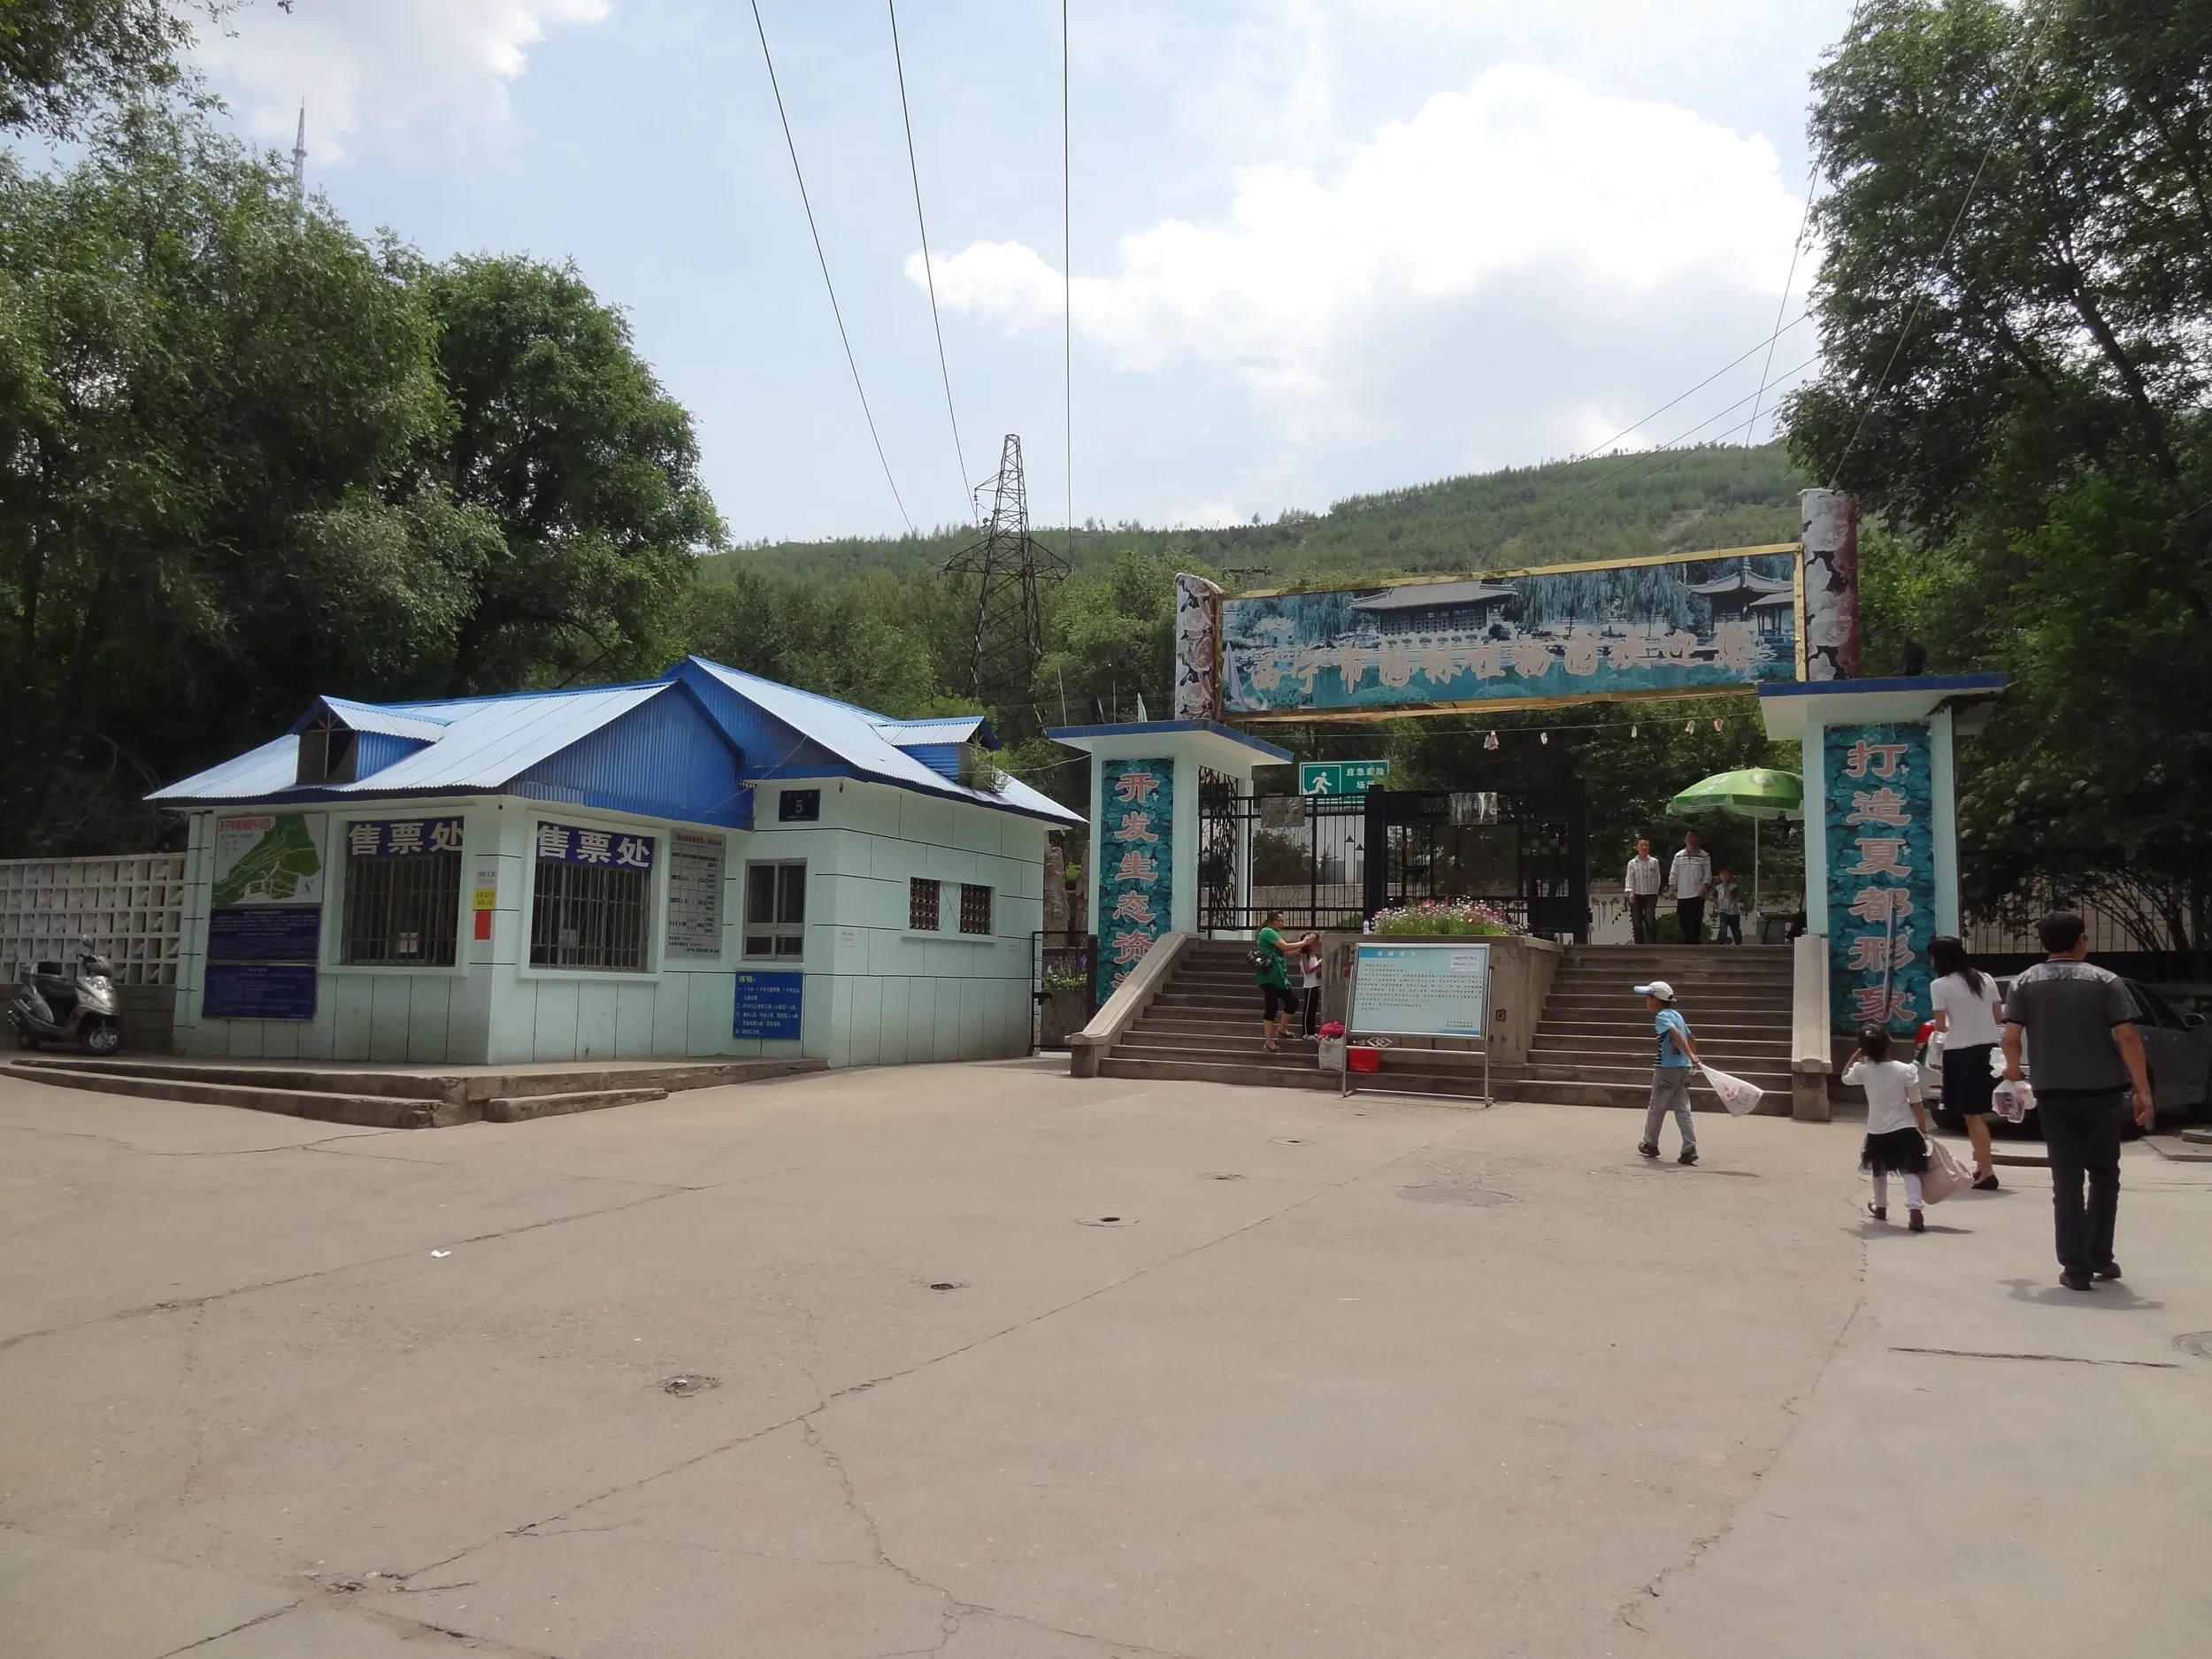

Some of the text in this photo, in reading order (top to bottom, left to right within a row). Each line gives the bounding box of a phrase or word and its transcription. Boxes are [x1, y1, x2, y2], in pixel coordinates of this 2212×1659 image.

[1346, 767, 1385, 777] 应急避险
[795, 799, 803, 814] 5
[349, 820, 465, 856] 售票处
[536, 825, 650, 868] 售票处
[1845, 740, 1917, 1022] 打造夏都形象
